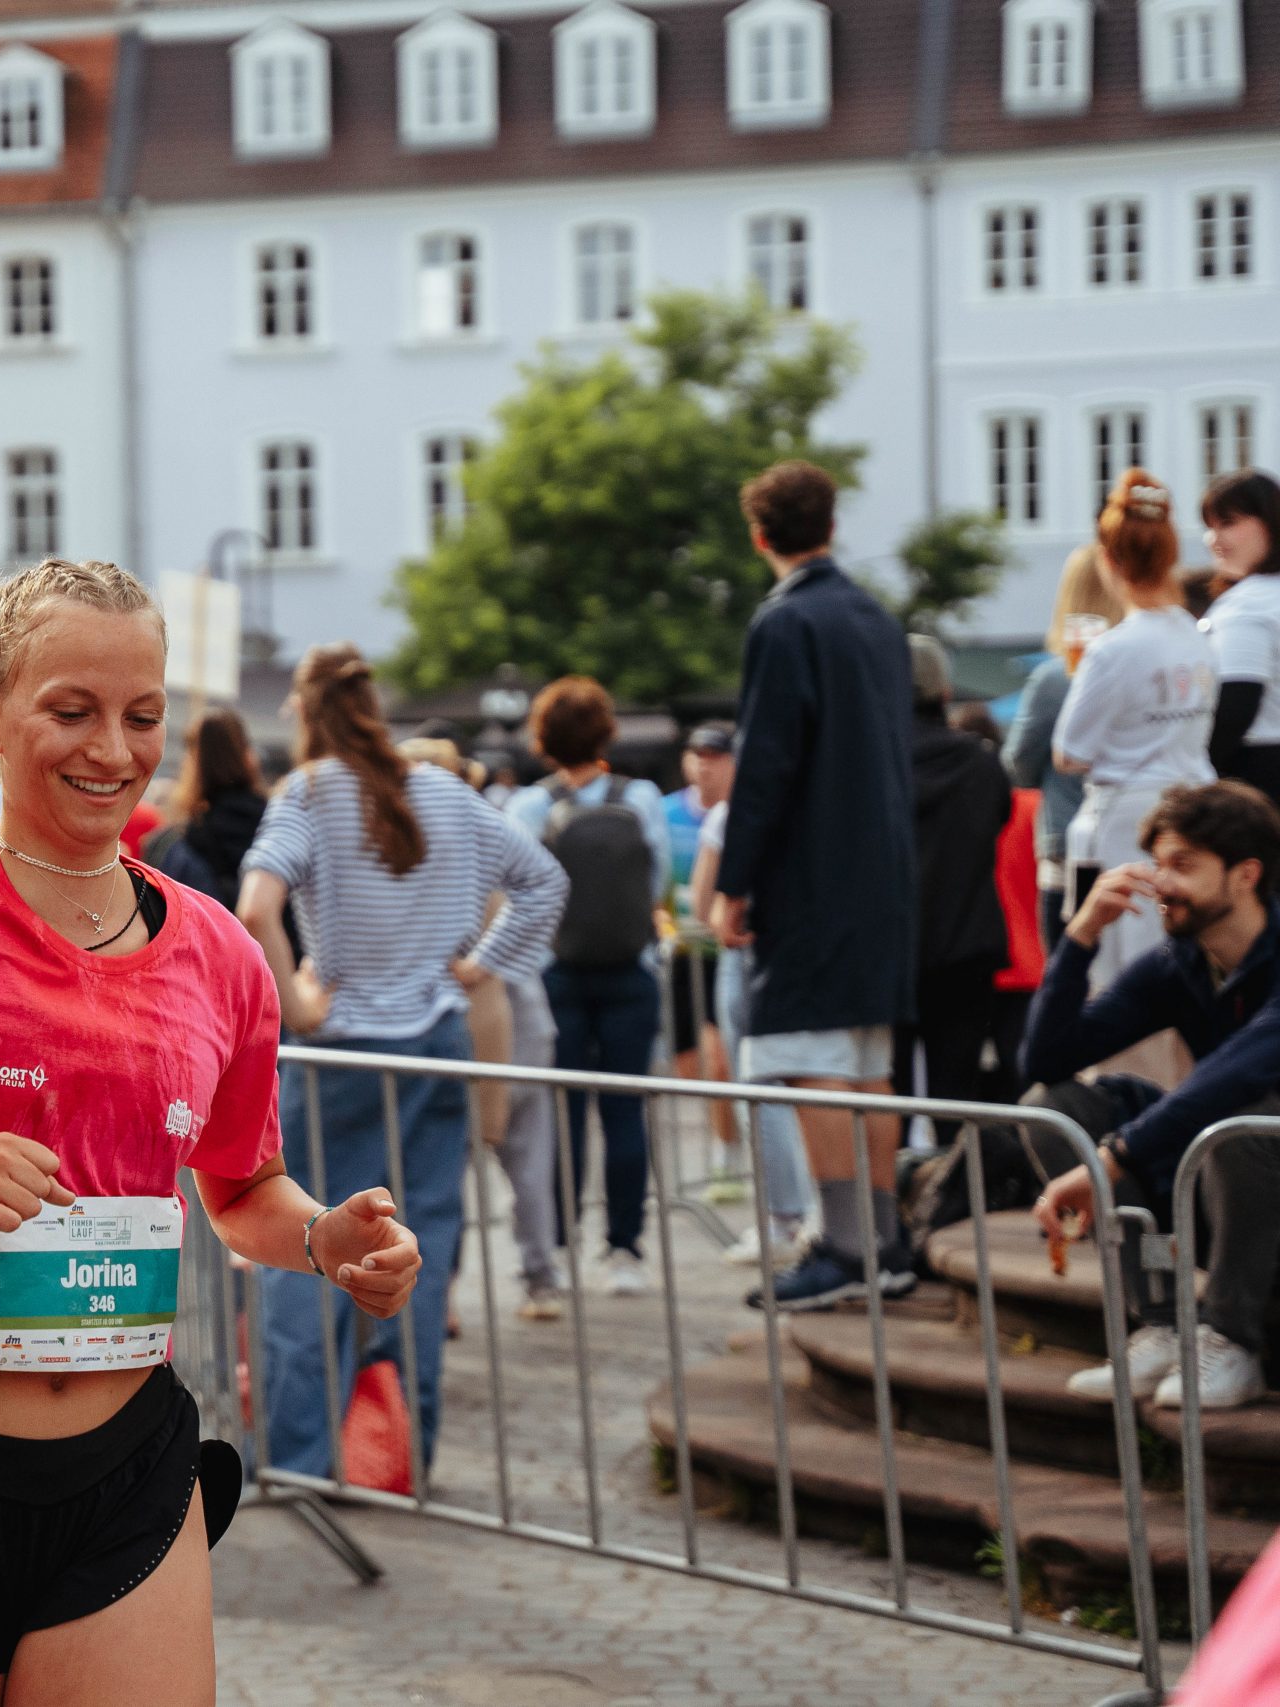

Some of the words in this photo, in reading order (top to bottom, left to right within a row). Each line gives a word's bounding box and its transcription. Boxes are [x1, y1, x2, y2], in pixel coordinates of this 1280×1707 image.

[71, 1204, 83, 1212] dm
[71, 1228, 93, 1238] LAUF
[60, 1257, 137, 1288] Jorina
[89, 1295, 116, 1312] 346
[5, 1335, 21, 1344] dm
